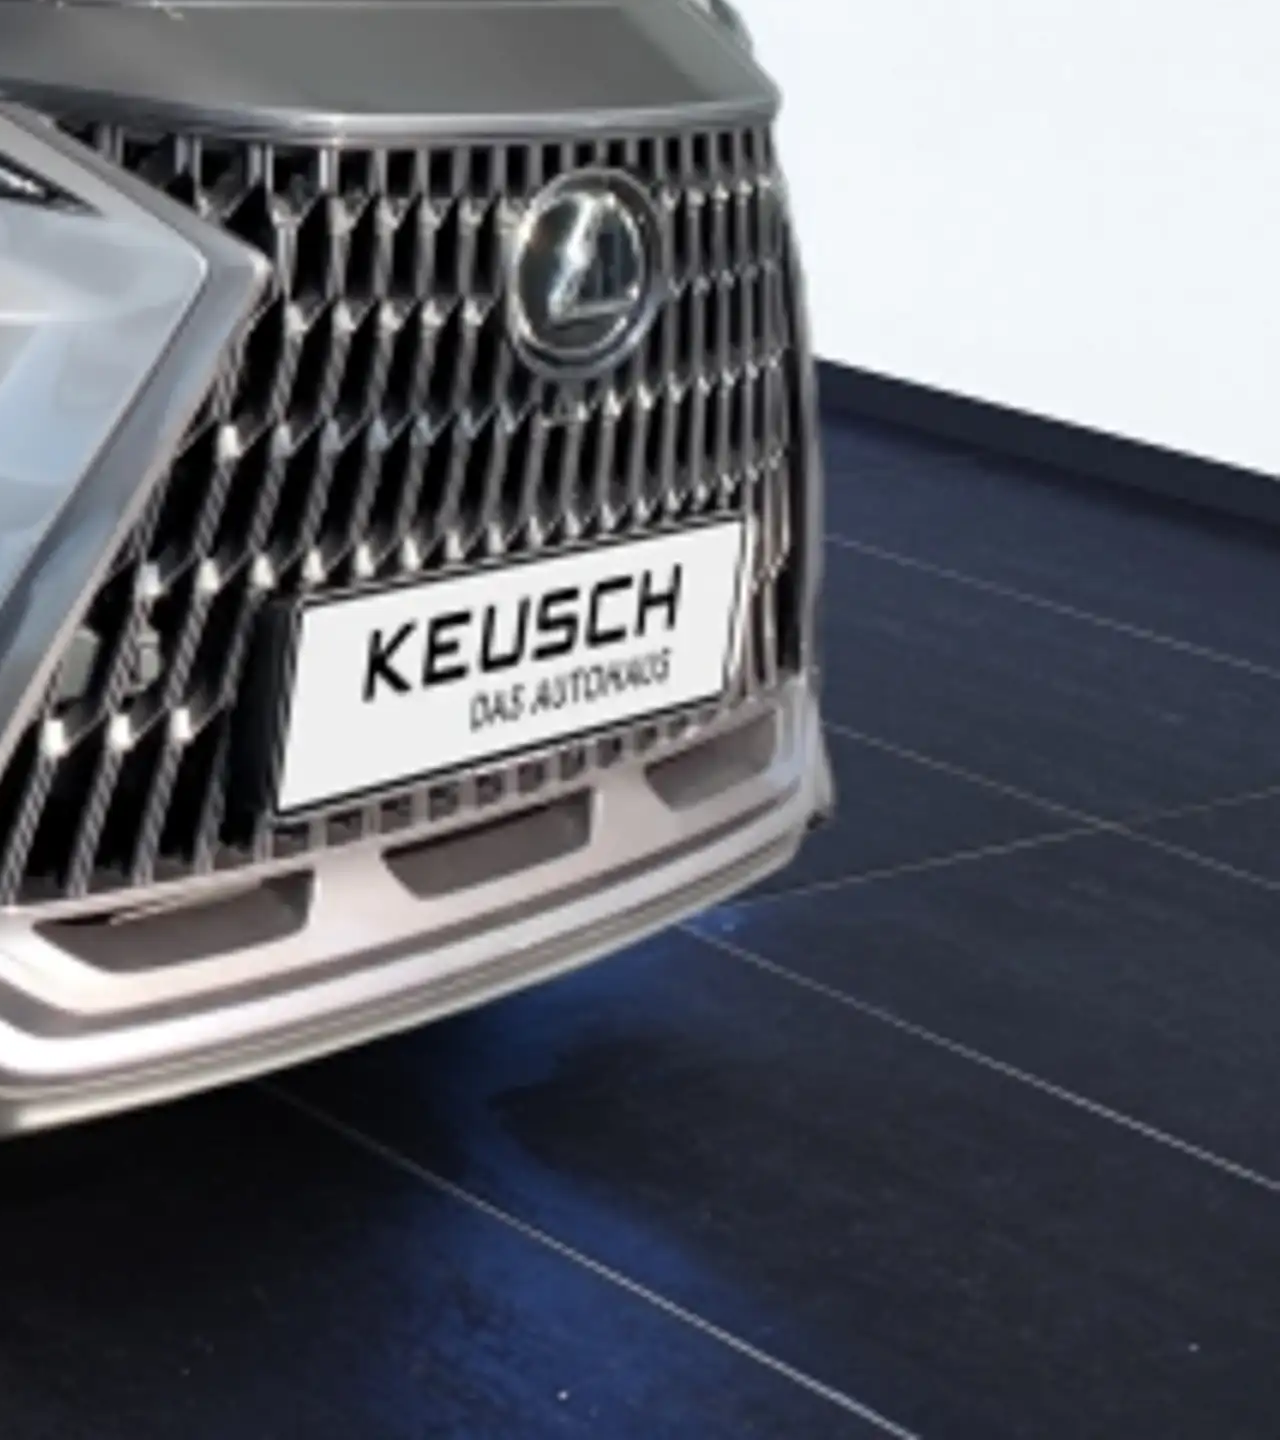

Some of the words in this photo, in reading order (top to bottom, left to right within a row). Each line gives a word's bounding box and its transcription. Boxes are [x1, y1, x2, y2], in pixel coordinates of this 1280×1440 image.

[362, 563, 683, 703] KEUSCH
[469, 685, 524, 733] DAS
[530, 648, 674, 716] AUTOHAUS
